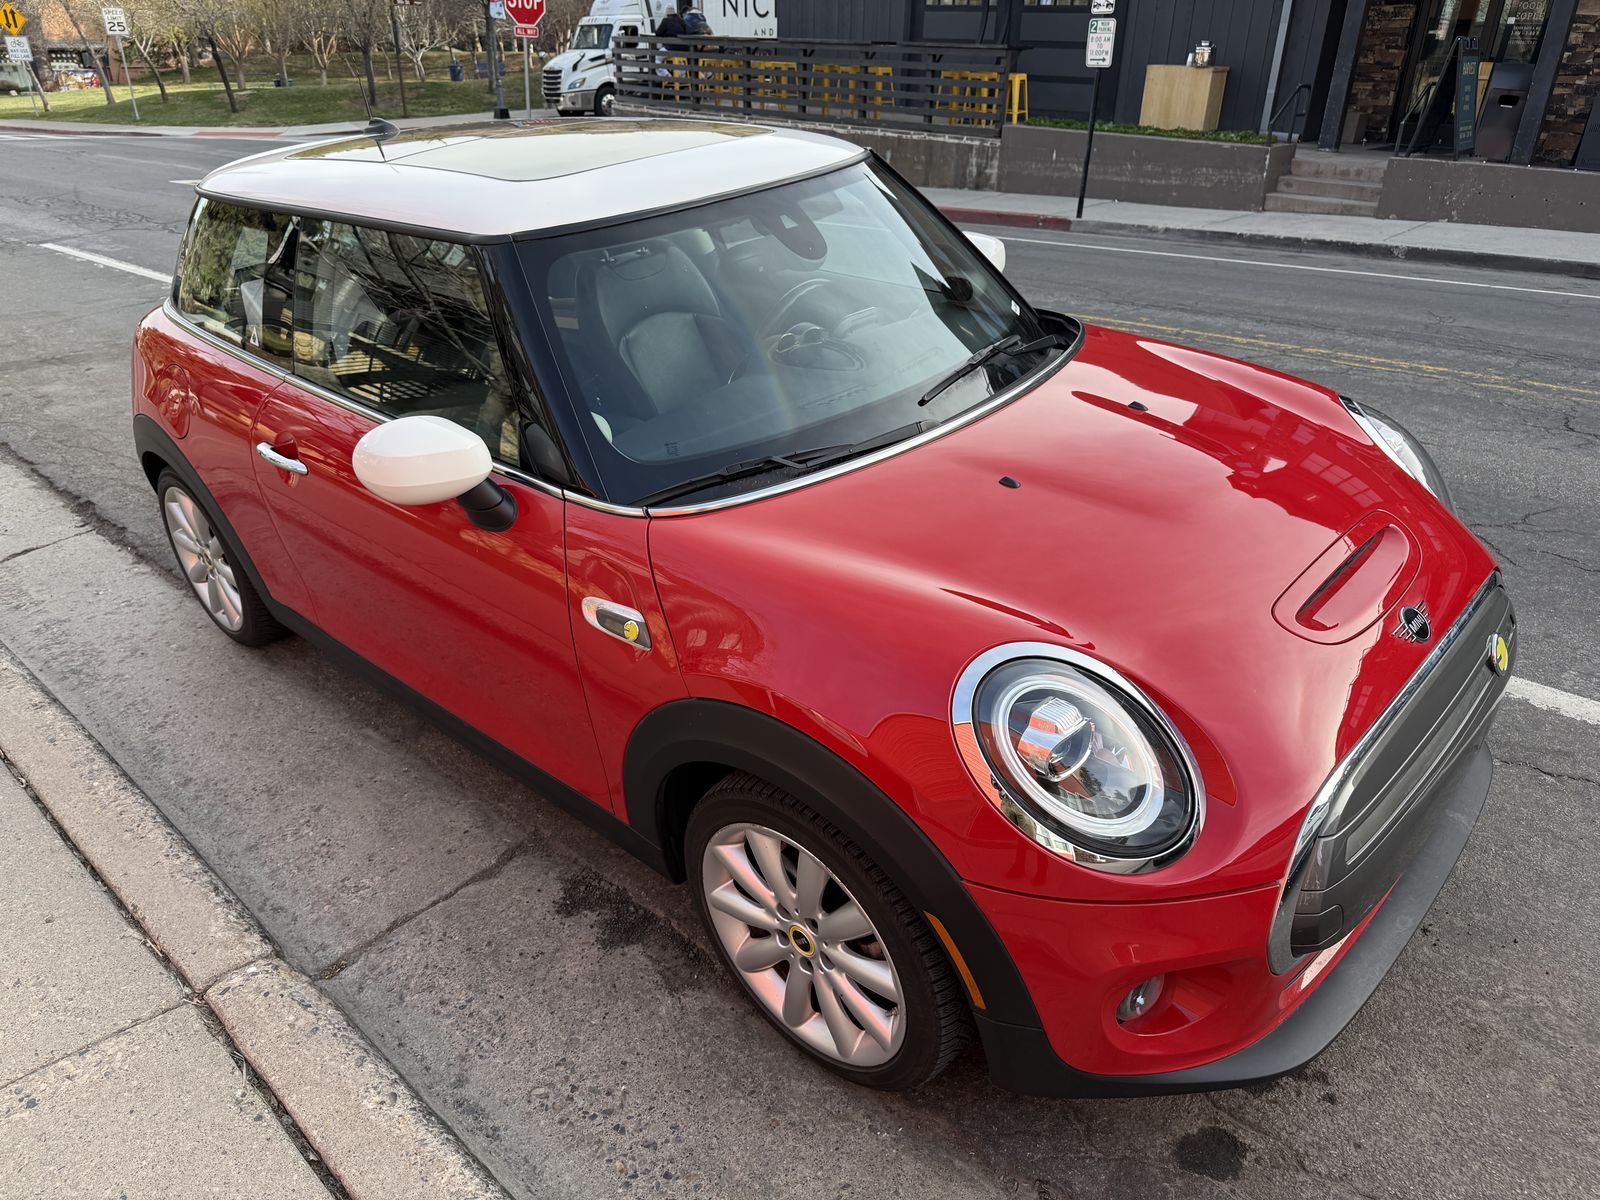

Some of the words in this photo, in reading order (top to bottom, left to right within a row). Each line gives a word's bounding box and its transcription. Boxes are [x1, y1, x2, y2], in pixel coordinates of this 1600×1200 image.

[508, 0, 542, 10] STOP
[722, 0, 778, 18] NIC
[107, 21, 126, 32] 25
[1090, 21, 1098, 33] 2
[753, 28, 775, 37] AND
[1409, 614, 1425, 633] MINI
